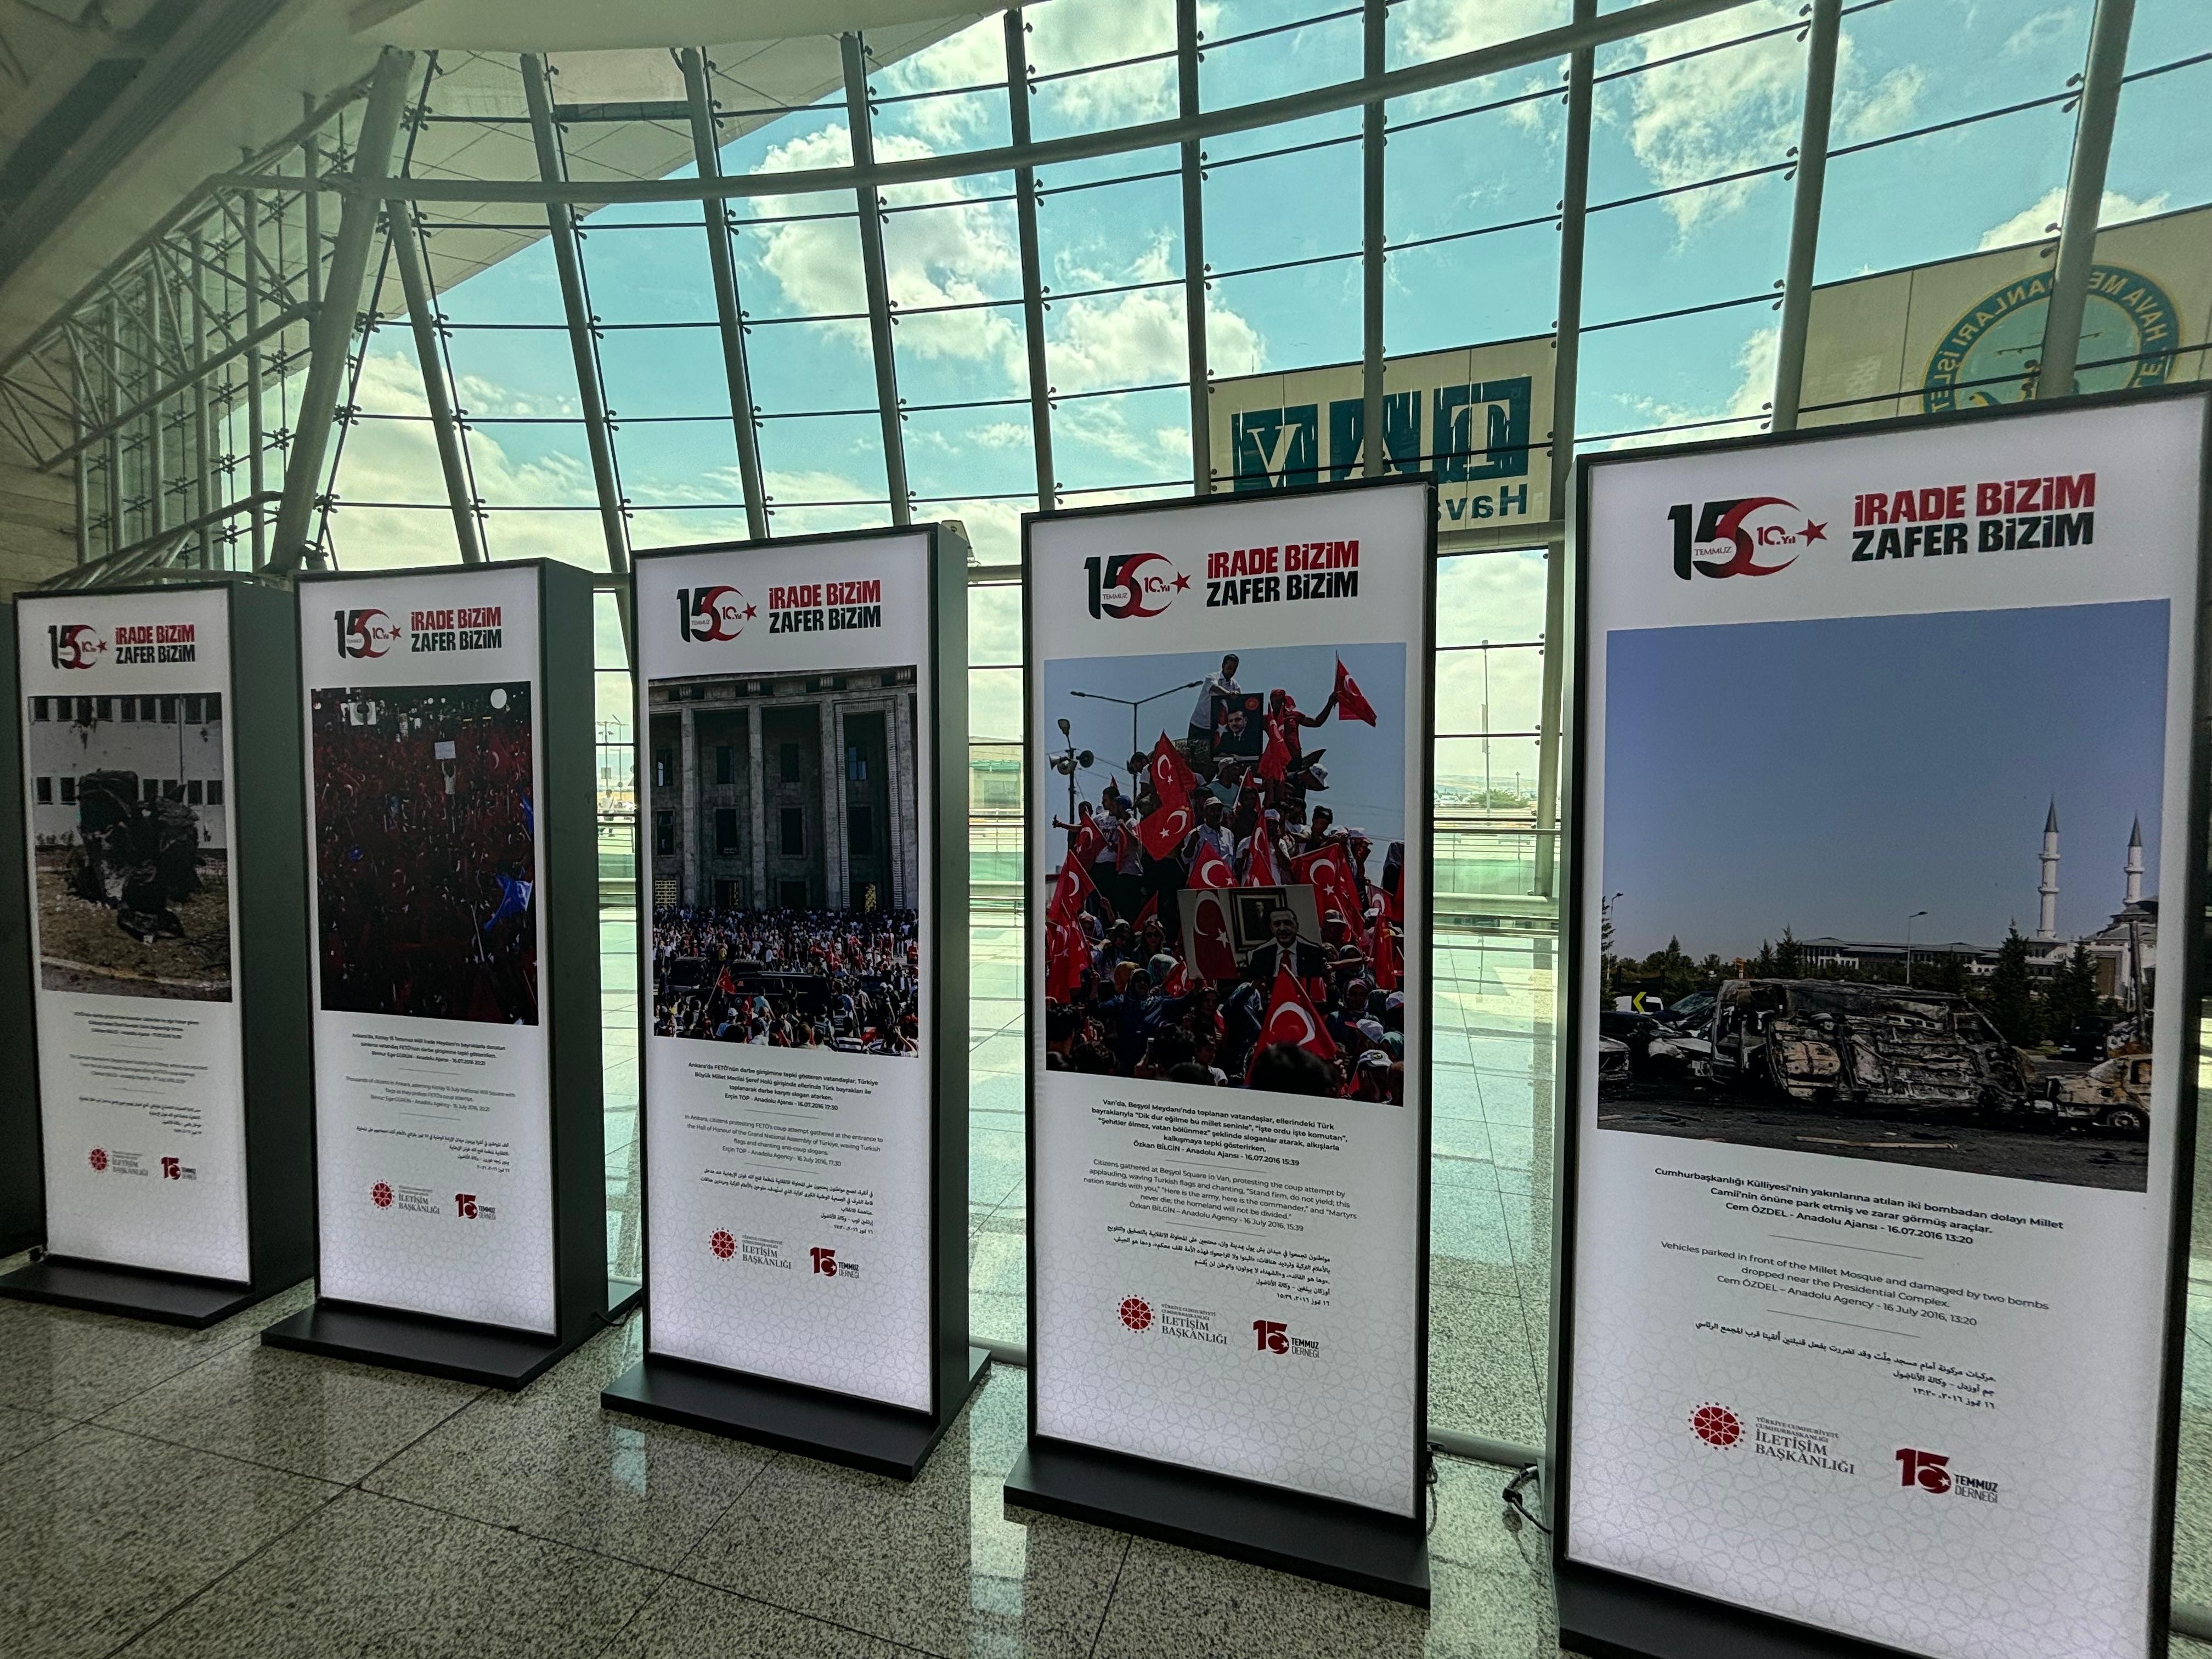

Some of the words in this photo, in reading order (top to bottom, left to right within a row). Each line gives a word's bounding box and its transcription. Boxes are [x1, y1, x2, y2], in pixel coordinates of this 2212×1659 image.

[1854, 484, 1966, 527] İRADE
[1977, 472, 2096, 517] BİZİM
[1668, 499, 1753, 580] 15
[1695, 546, 1732, 556] TEMMUZ
[1852, 523, 1968, 562] ZAFER
[1978, 512, 2094, 553] BİZİM
[1207, 546, 1278, 579] İRADE
[1285, 540, 1359, 572] BİZİM
[769, 584, 821, 610] İRADE
[826, 580, 881, 606] BİZİM
[1084, 554, 1143, 619] 15
[1207, 577, 1280, 607] ZAFER
[1286, 571, 1358, 600] BİZİM
[676, 586, 721, 642] 15
[769, 610, 823, 634] ZAFER
[828, 605, 881, 630] BİZİM
[116, 647, 155, 664] ZAFER
[411, 631, 456, 652] ZAFER
[1128, 1102, 1150, 1110] Beşyol
[1197, 1109, 1229, 1118] toplanan
[1276, 1118, 1315, 1127] ellerindeki
[1316, 1122, 1334, 1130] Türk
[1133, 1139, 1155, 1149] Özkan
[1156, 1143, 1180, 1152] BİLGİN
[1186, 1147, 1216, 1156] Anadolu
[1217, 1150, 1239, 1159] Ajansı
[1244, 1153, 1280, 1164] 16.07.2016
[1163, 1134, 1202, 1146] kalkışmaya
[1223, 1142, 1266, 1152] gösterirken.
[1186, 1199, 1221, 1210] homeland
[1655, 1167, 1744, 1187] Cumhurbaşkanlığı
[1810, 1189, 1870, 1202] yakınlarına
[1873, 1197, 1905, 1207] atılan
[1907, 1200, 1921, 1210] iki
[1924, 1203, 1987, 1219] bombadan
[1990, 1212, 2026, 1225] dolayı
[2030, 1217, 2064, 1229] Millet
[1129, 1200, 1150, 1210] Özkan
[1152, 1204, 1175, 1214] BİLGİN
[1181, 1209, 1210, 1218] Anadolu
[1211, 1213, 1238, 1223] Agency
[1252, 1218, 1267, 1228] July
[1286, 1223, 1304, 1232] 15:39
[1725, 1202, 1749, 1212] Cem
[1751, 1204, 1788, 1217] ÖZDEL
[1796, 1212, 1841, 1225] Anadolu
[1843, 1219, 1877, 1230] Ajansı
[1887, 1224, 1943, 1240] 16.07.2016
[1944, 1233, 1973, 1244] 13:20
[1760, 1194, 1794, 1205] önüne
[1796, 1200, 1820, 1209] park
[1821, 1204, 1854, 1215] etmiş
[1871, 1210, 1900, 1220] zarar
[1902, 1215, 1947, 1228] görmüş
[1949, 1222, 1993, 1233] araçlar.
[742, 1243, 778, 1258] İLETİŞİM
[743, 1254, 792, 1270] BAŞKANLIĞI
[838, 1261, 859, 1272] TEMMUZ
[1661, 1240, 1700, 1253] Vehicles
[1701, 1249, 1735, 1259] parked
[1737, 1252, 1747, 1261] in
[1749, 1254, 1774, 1266] front
[1788, 1261, 1807, 1270] the
[1809, 1264, 1838, 1276] Millet
[1840, 1269, 1883, 1283] Mosque
[1885, 1278, 1906, 1286] and
[1909, 1281, 1963, 1296] damaged
[1966, 1289, 1980, 1300] by
[1983, 1293, 2005, 1302] two
[2007, 1296, 2050, 1310] bombs
[1741, 1266, 1785, 1280] dropped
[1787, 1275, 1810, 1284] near
[1812, 1278, 1830, 1288] the
[1832, 1281, 1895, 1298] Presidential
[1717, 1275, 1740, 1285] Cem
[1742, 1278, 1778, 1291] ÖZDEL
[1787, 1287, 1831, 1301] Anadolu
[1833, 1295, 1874, 1310] Agency
[1883, 1302, 1894, 1312] 16
[1895, 1305, 1918, 1317] July
[1920, 1309, 1948, 1322] 2016,
[1949, 1314, 1977, 1326] 13:20
[1162, 1314, 1209, 1331] İLETİŞİM
[1163, 1325, 1227, 1344] BAŞKANLIĞI
[1253, 1319, 1289, 1355] 15
[1291, 1337, 1319, 1350] TEMMUZ
[1756, 1429, 1828, 1456] İLETİŞİM
[1756, 1443, 1855, 1474] BAŞKANLIĞI
[1895, 1448, 1951, 1494] 15
[1955, 1474, 1998, 1493] TEMMUZ
